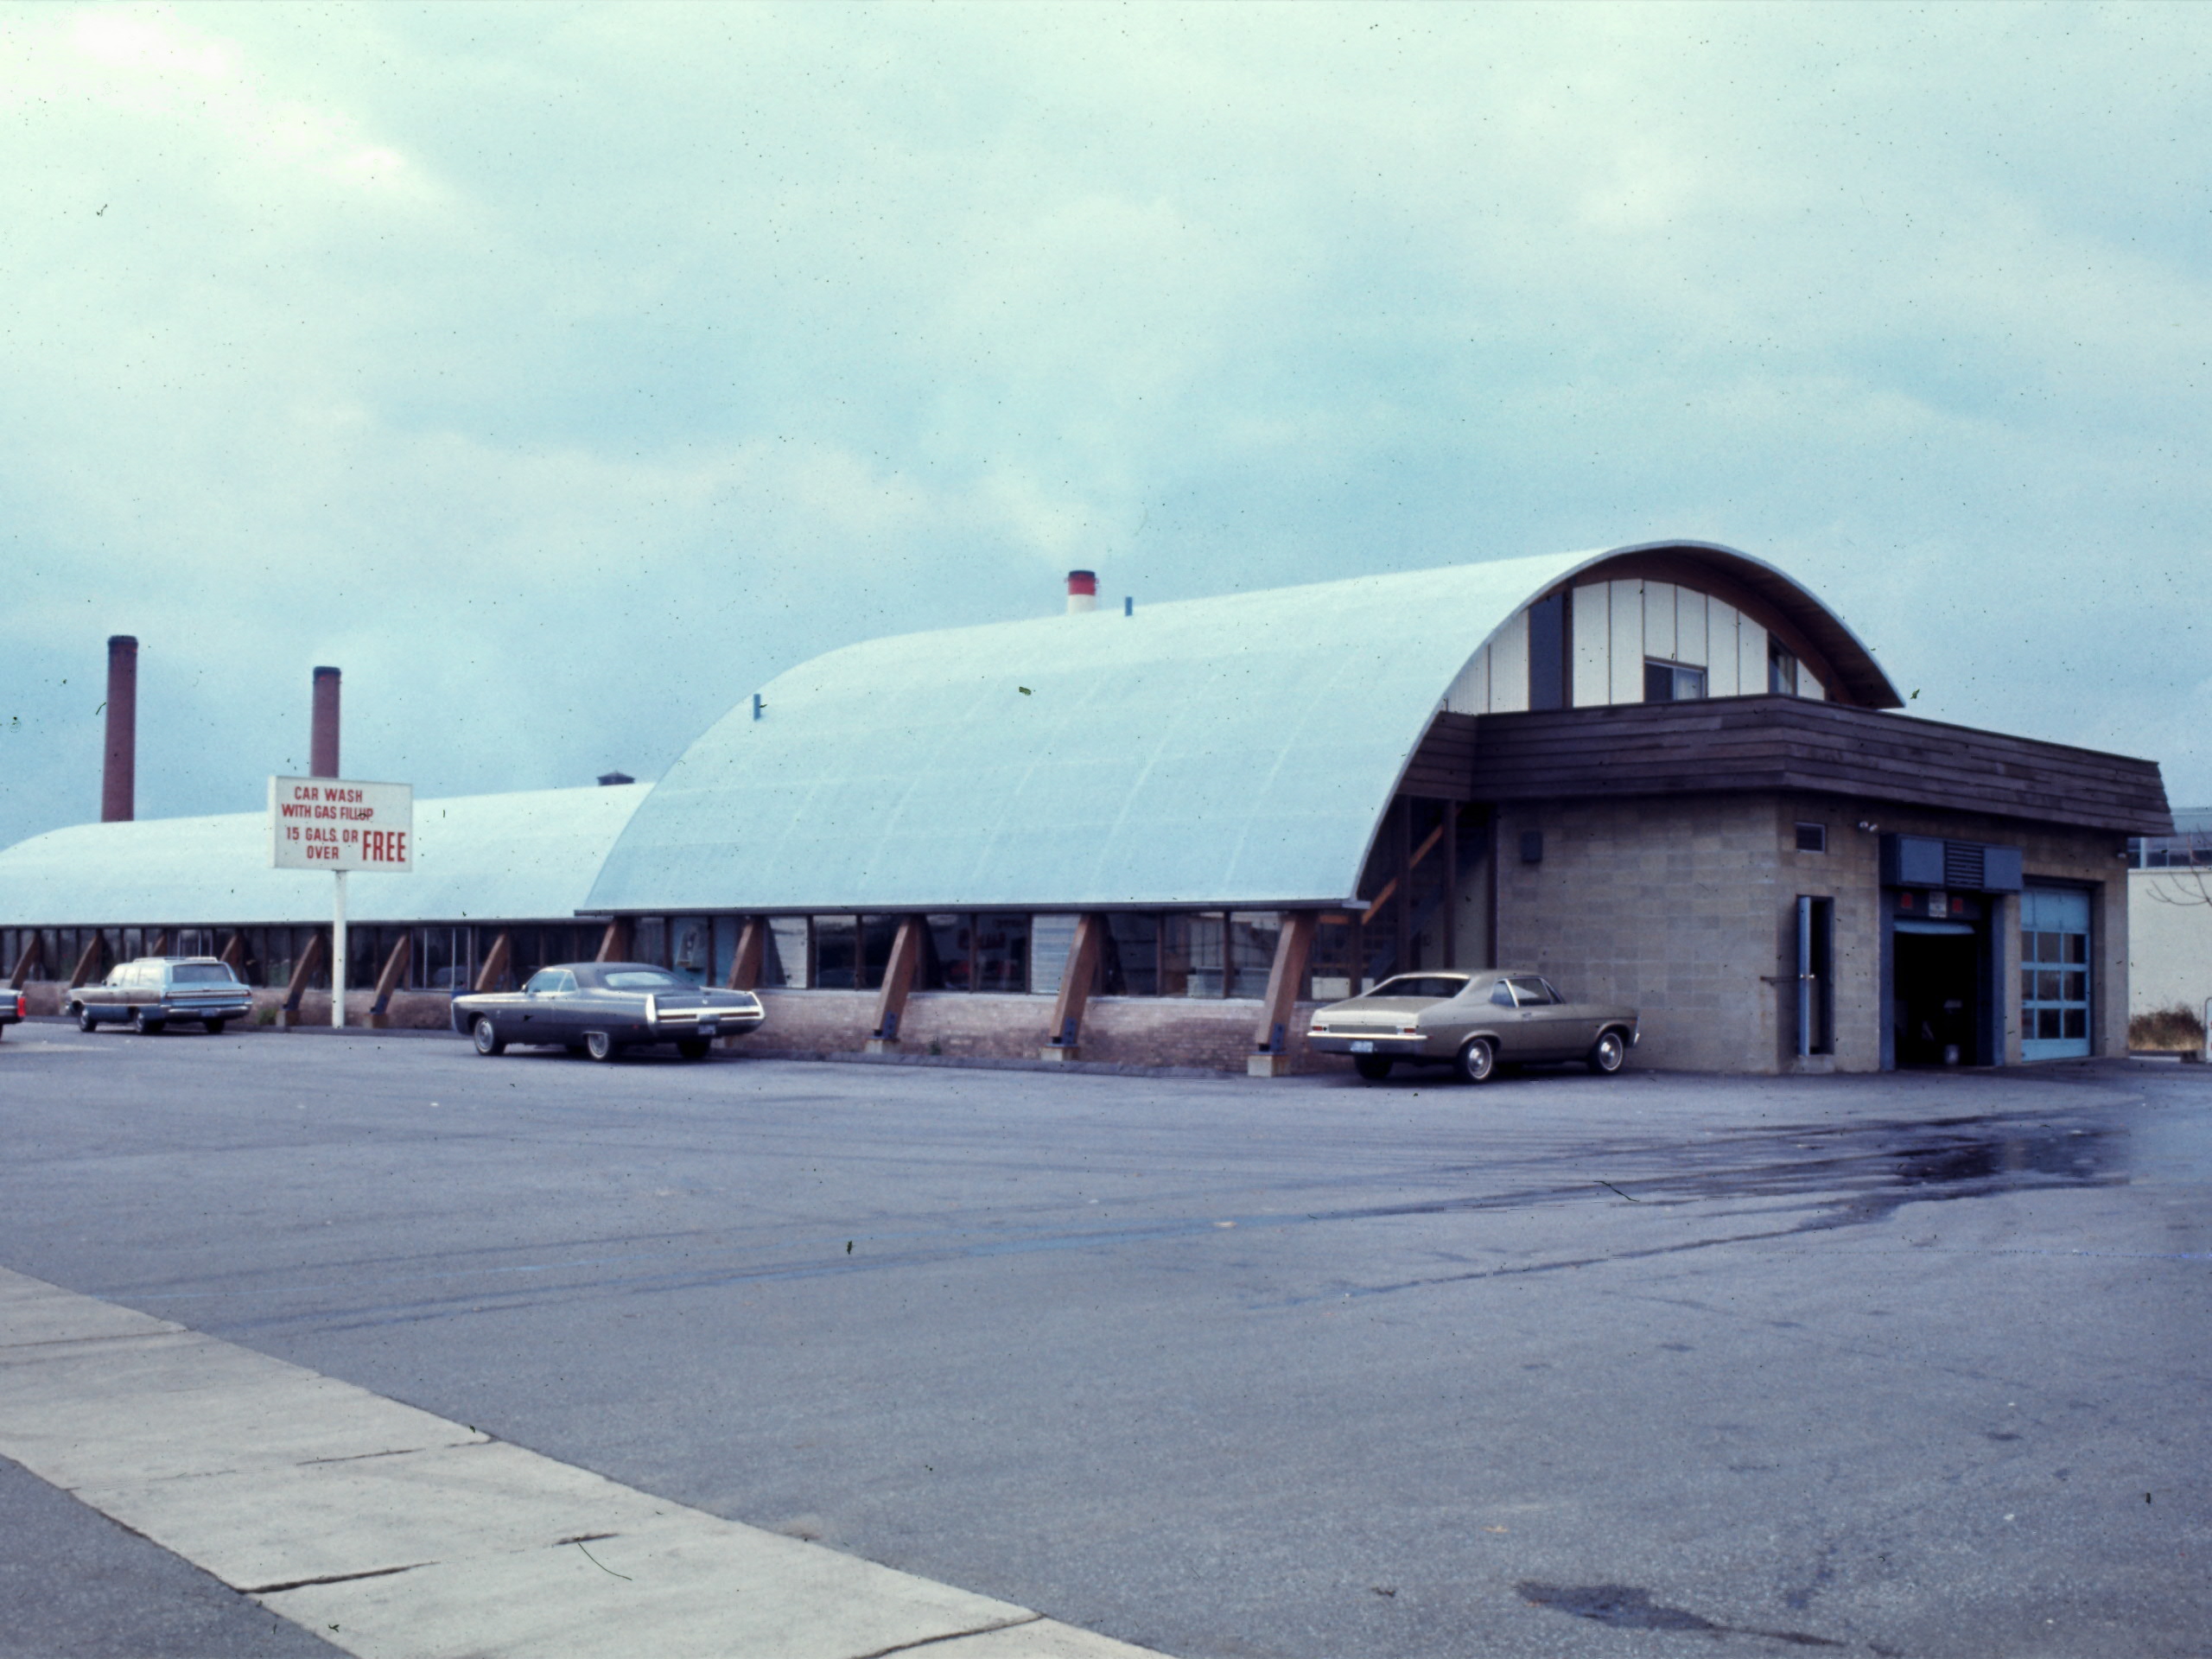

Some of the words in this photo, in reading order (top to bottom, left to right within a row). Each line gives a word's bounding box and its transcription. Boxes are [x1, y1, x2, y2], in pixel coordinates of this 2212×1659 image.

[295, 786, 319, 801] CAR
[325, 788, 363, 802] WASH
[282, 804, 311, 817] WITH
[315, 805, 336, 819] GAS
[287, 827, 299, 840] 15
[343, 830, 358, 842] OR
[307, 845, 339, 859] OVER
[363, 830, 406, 861] FREE
